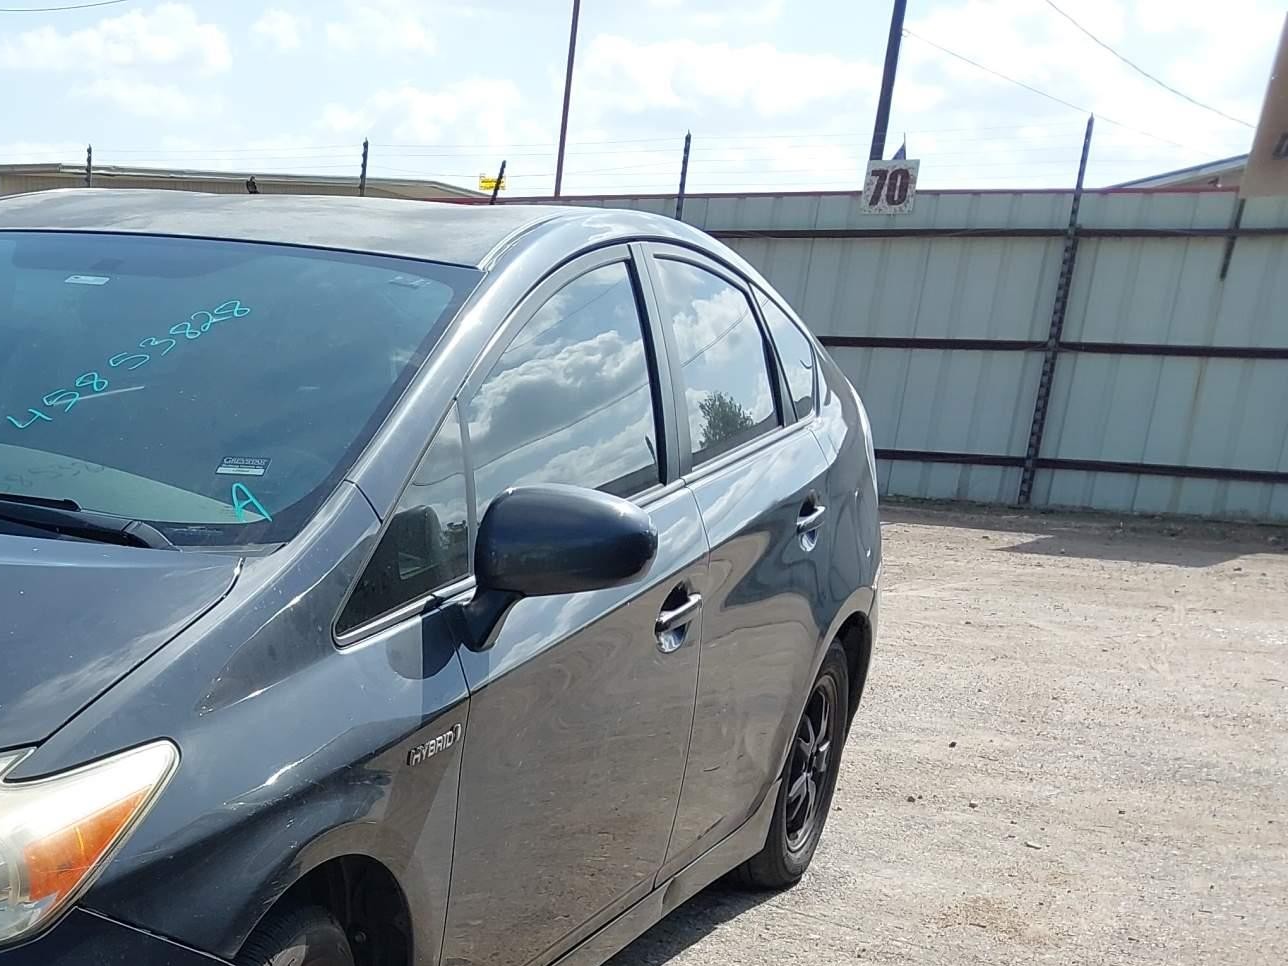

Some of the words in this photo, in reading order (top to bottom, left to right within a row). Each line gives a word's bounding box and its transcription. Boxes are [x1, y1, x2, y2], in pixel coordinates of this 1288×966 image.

[869, 168, 910, 206] 70
[232, 483, 273, 523] A
[411, 730, 454, 766] HYBRID
